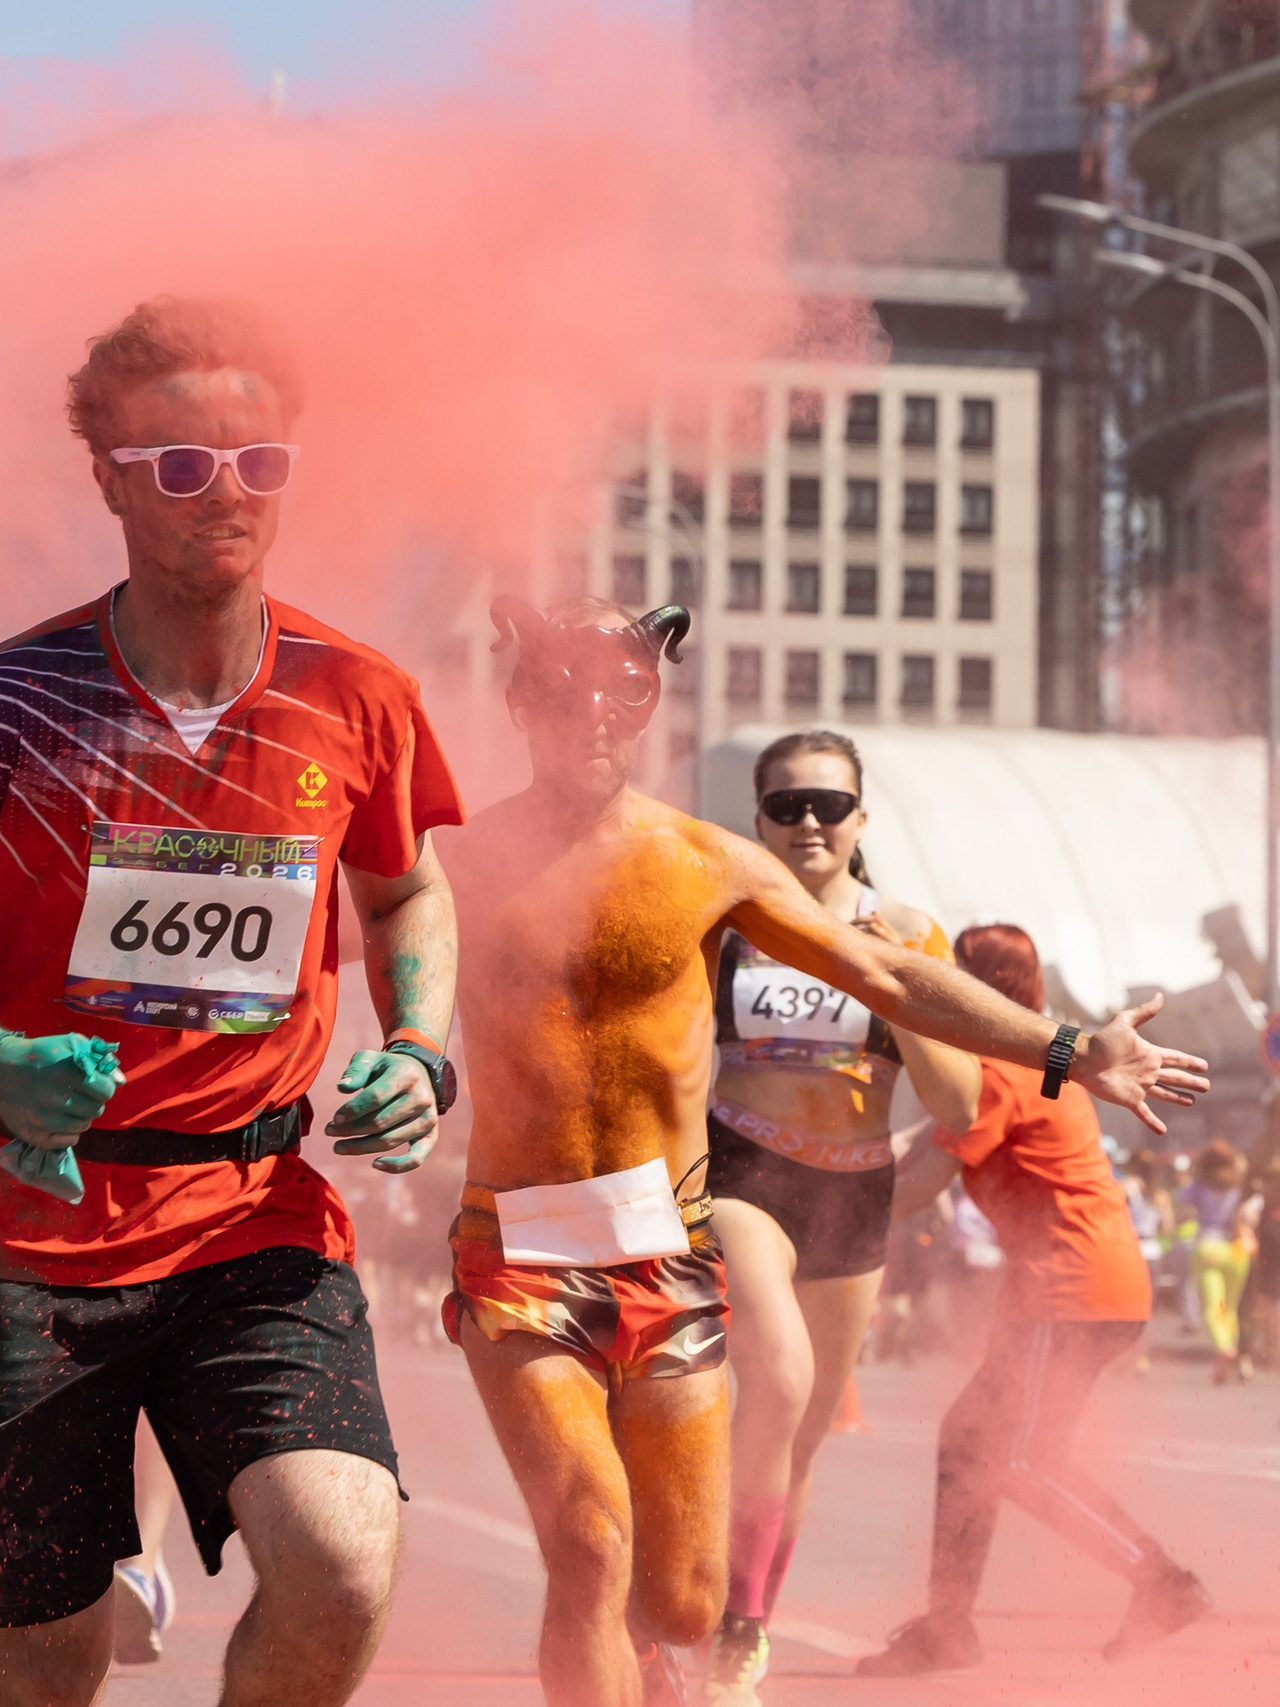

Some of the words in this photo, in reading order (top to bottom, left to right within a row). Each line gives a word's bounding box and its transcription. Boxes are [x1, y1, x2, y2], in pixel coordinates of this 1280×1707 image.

[111, 857, 210, 871] ЗАБЕГ
[112, 828, 301, 865] КРАСОЧНЫЙ
[220, 862, 313, 881] 2026
[109, 899, 273, 963] 6690
[751, 985, 849, 1023] 4397
